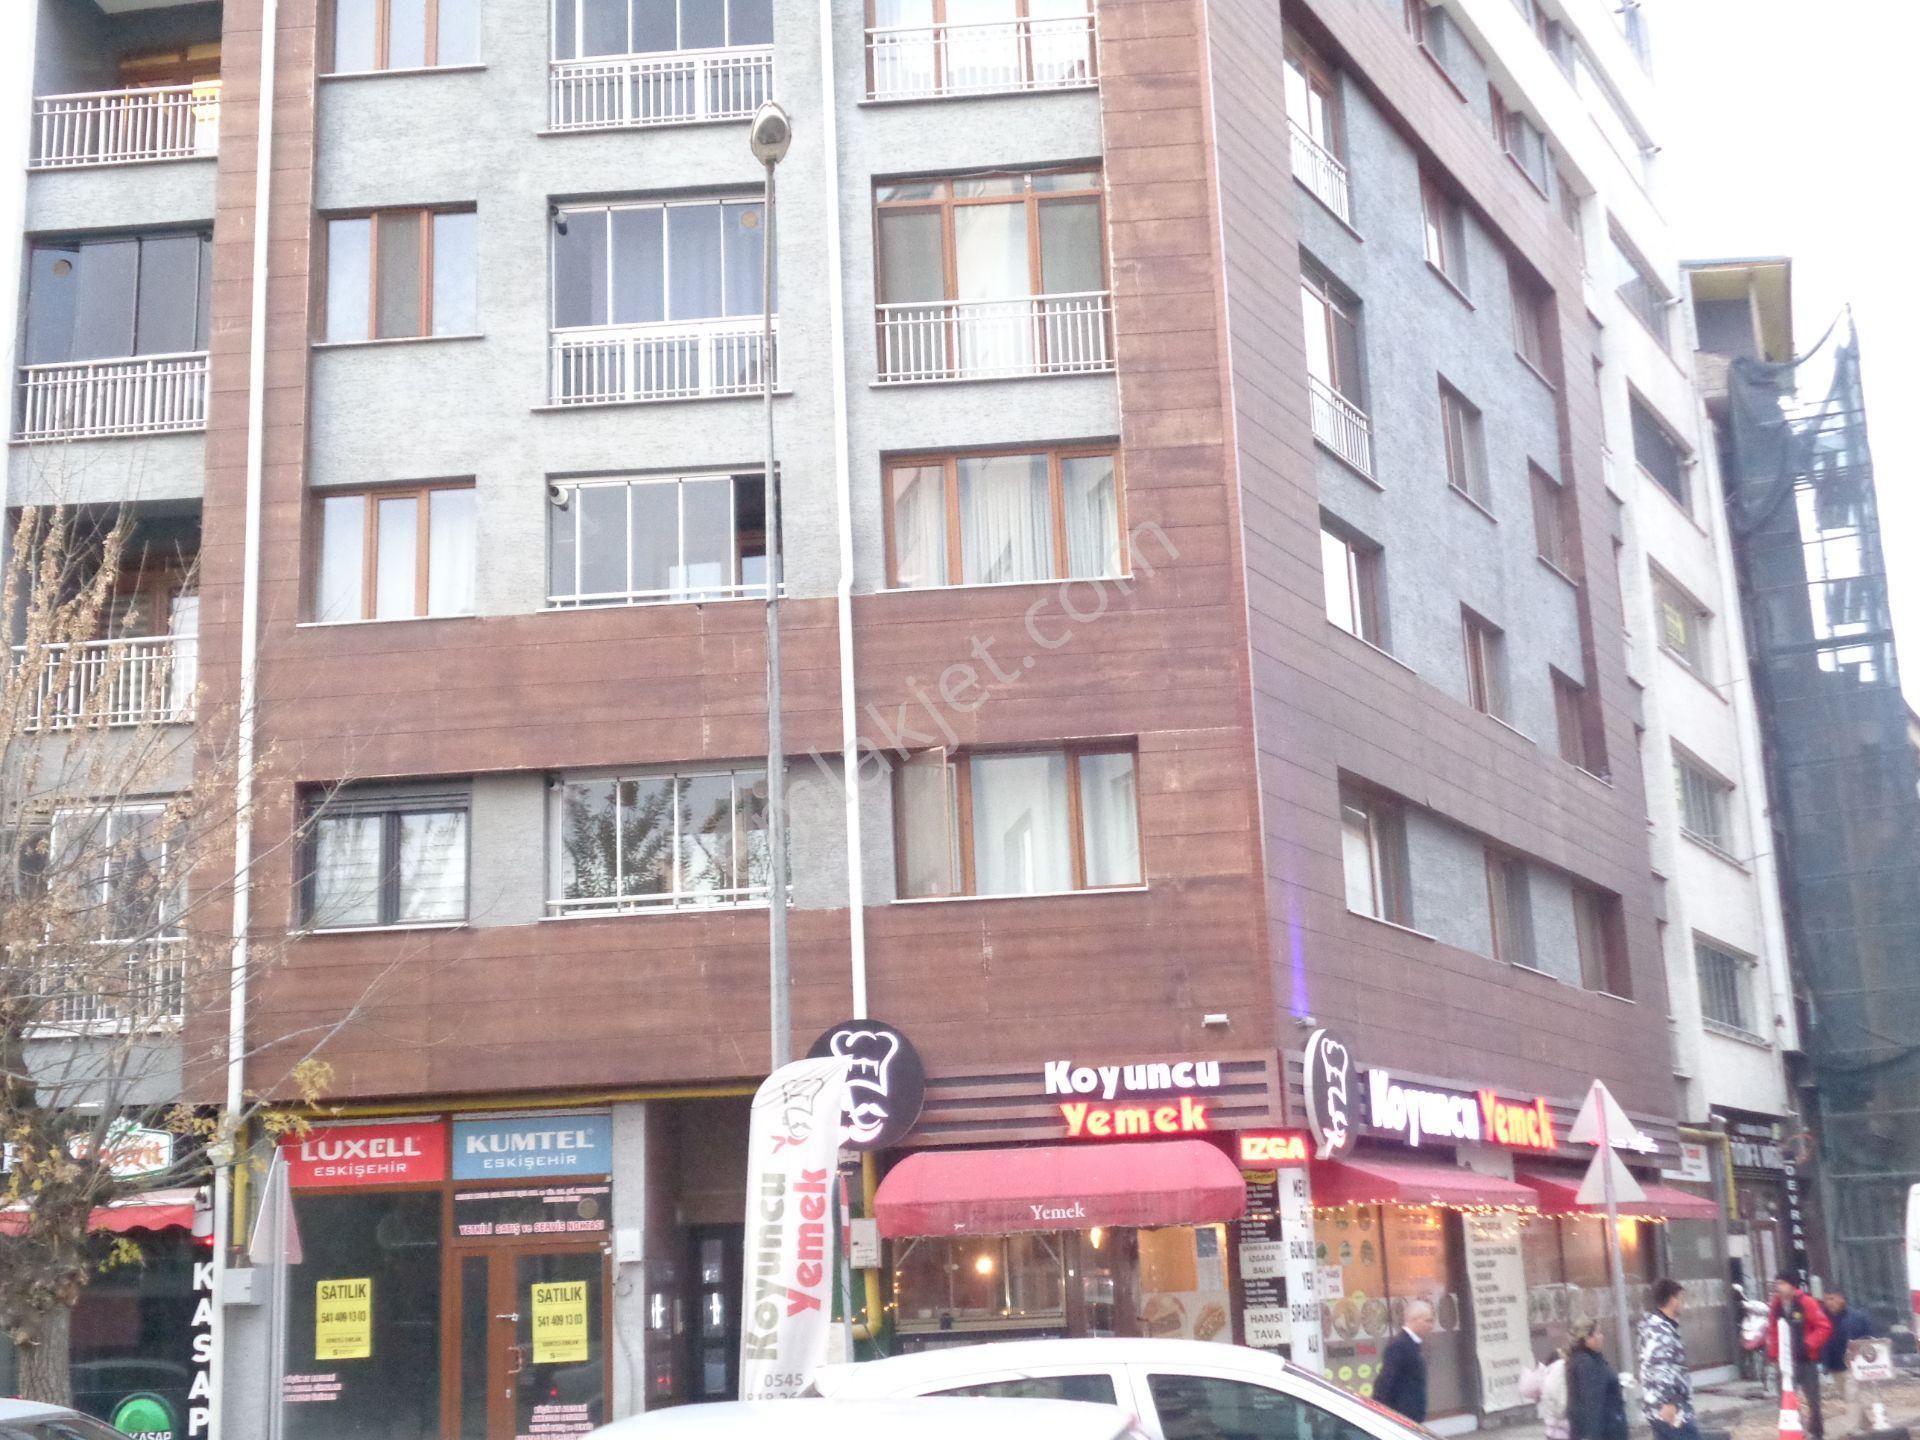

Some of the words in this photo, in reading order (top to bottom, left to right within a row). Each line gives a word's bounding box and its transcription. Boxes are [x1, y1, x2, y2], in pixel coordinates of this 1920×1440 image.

[1044, 1059, 1220, 1099] Koyuncu
[1059, 1096, 1209, 1137] Yemek
[1368, 1068, 1480, 1147] Koyuncu
[1478, 1087, 1557, 1149] Yemek
[301, 1137, 421, 1162] LUXELL
[466, 1130, 595, 1154] KUMTEL
[1240, 1136, 1307, 1160] IZGA
[313, 1162, 407, 1178] ESKİŞEHİR
[483, 1153, 577, 1169] ESKİŞEHİR
[1030, 1202, 1086, 1220] Yemek
[786, 1167, 828, 1318] Yemek
[746, 1172, 786, 1361] Koyuncu
[321, 1284, 367, 1301] SATILIK
[537, 1286, 582, 1304] SATILIK
[1250, 1311, 1284, 1323] HAMSİ
[1253, 1329, 1282, 1340] TAVA
[188, 1262, 214, 1436] KASAP
[764, 1373, 803, 1387] 0545
